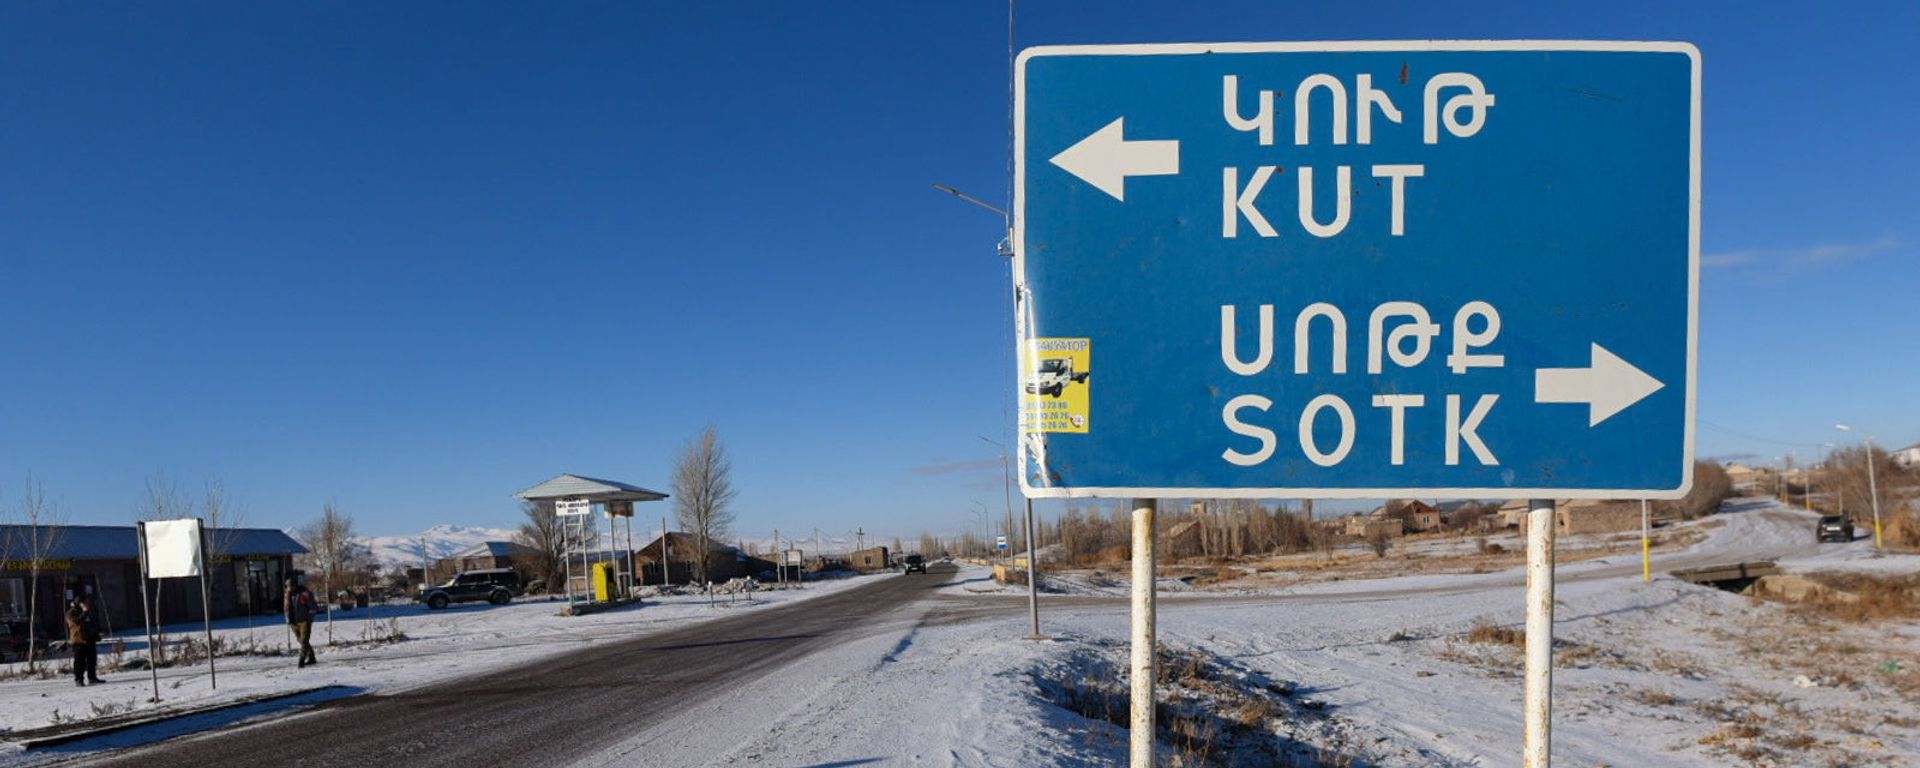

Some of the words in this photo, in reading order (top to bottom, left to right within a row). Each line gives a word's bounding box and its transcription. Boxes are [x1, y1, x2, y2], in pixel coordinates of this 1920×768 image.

[1223, 72, 1495, 145] ԿՈՒԹ
[1222, 164, 1424, 238] KUT
[1221, 301, 1505, 376] ՍՈԹՔ
[1222, 394, 1500, 467] SOTK
